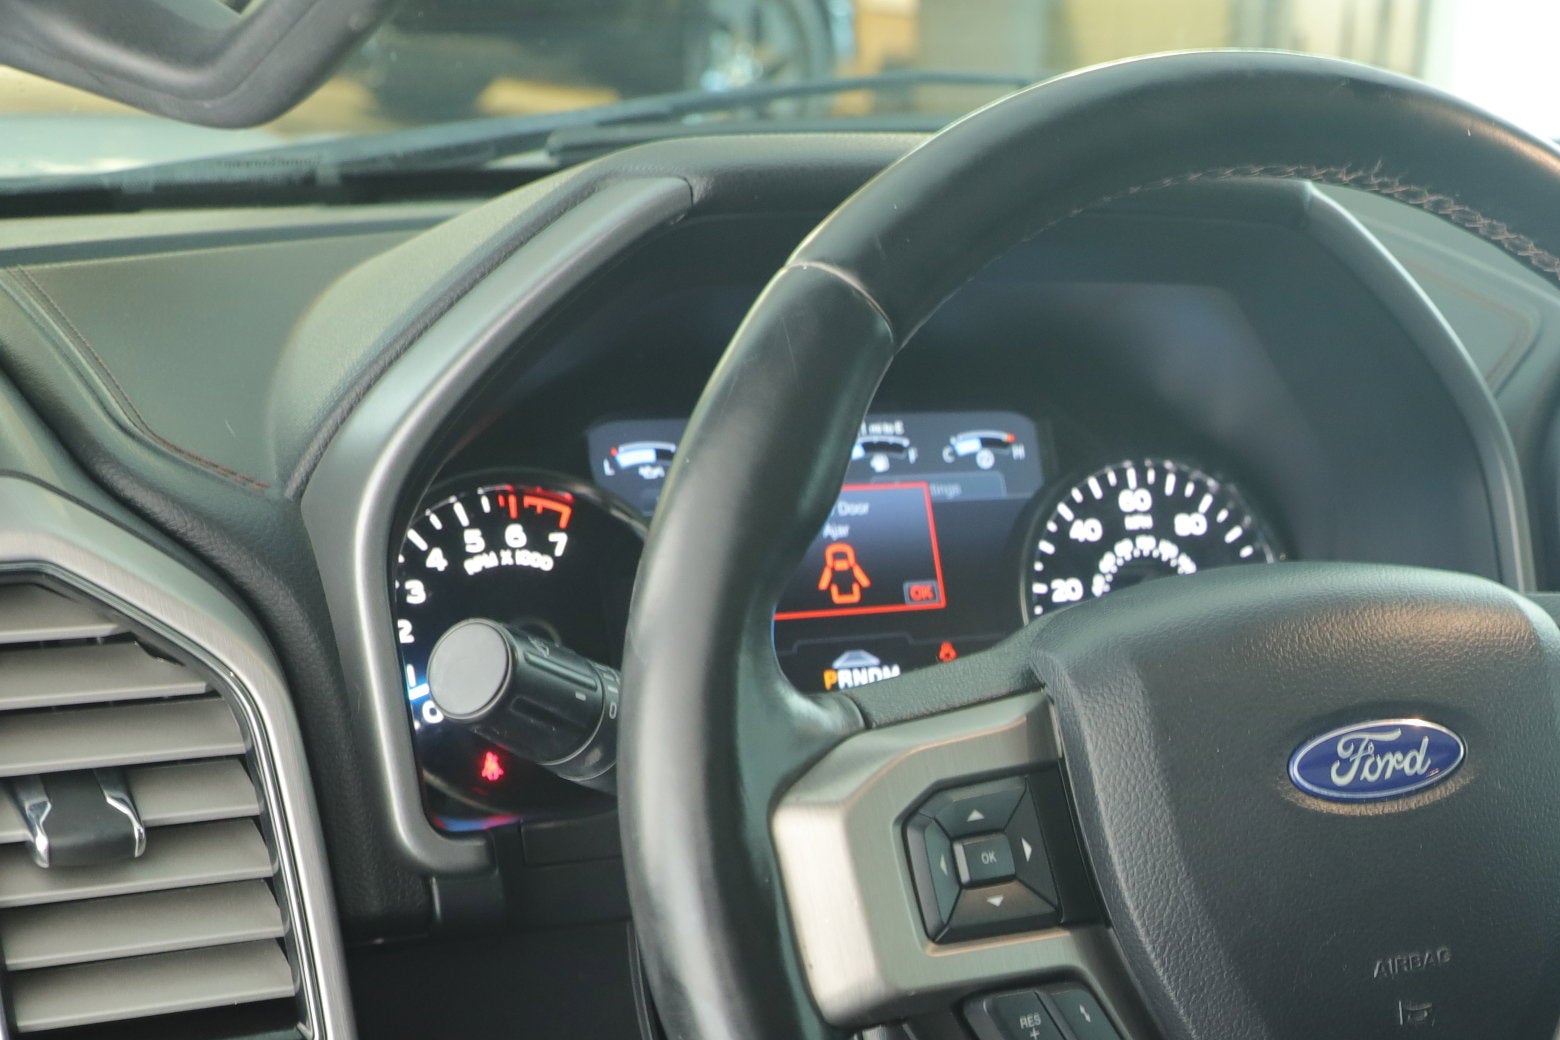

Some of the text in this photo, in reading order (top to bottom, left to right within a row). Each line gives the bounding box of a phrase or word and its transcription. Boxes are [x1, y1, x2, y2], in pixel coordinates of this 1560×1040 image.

[463, 528, 485, 553] 5
[504, 523, 527, 548] 6
[1069, 518, 1103, 542] 40
[548, 532, 568, 557] 7
[425, 547, 448, 572] 4
[404, 579, 426, 604] 3
[909, 584, 935, 602] OK
[1050, 577, 1084, 602] 20
[397, 618, 415, 644] 2
[1330, 727, 1431, 787] Ford
[980, 850, 998, 865] OK
[1372, 945, 1452, 980] AIRBAG
[1019, 1012, 1042, 1030] RES
